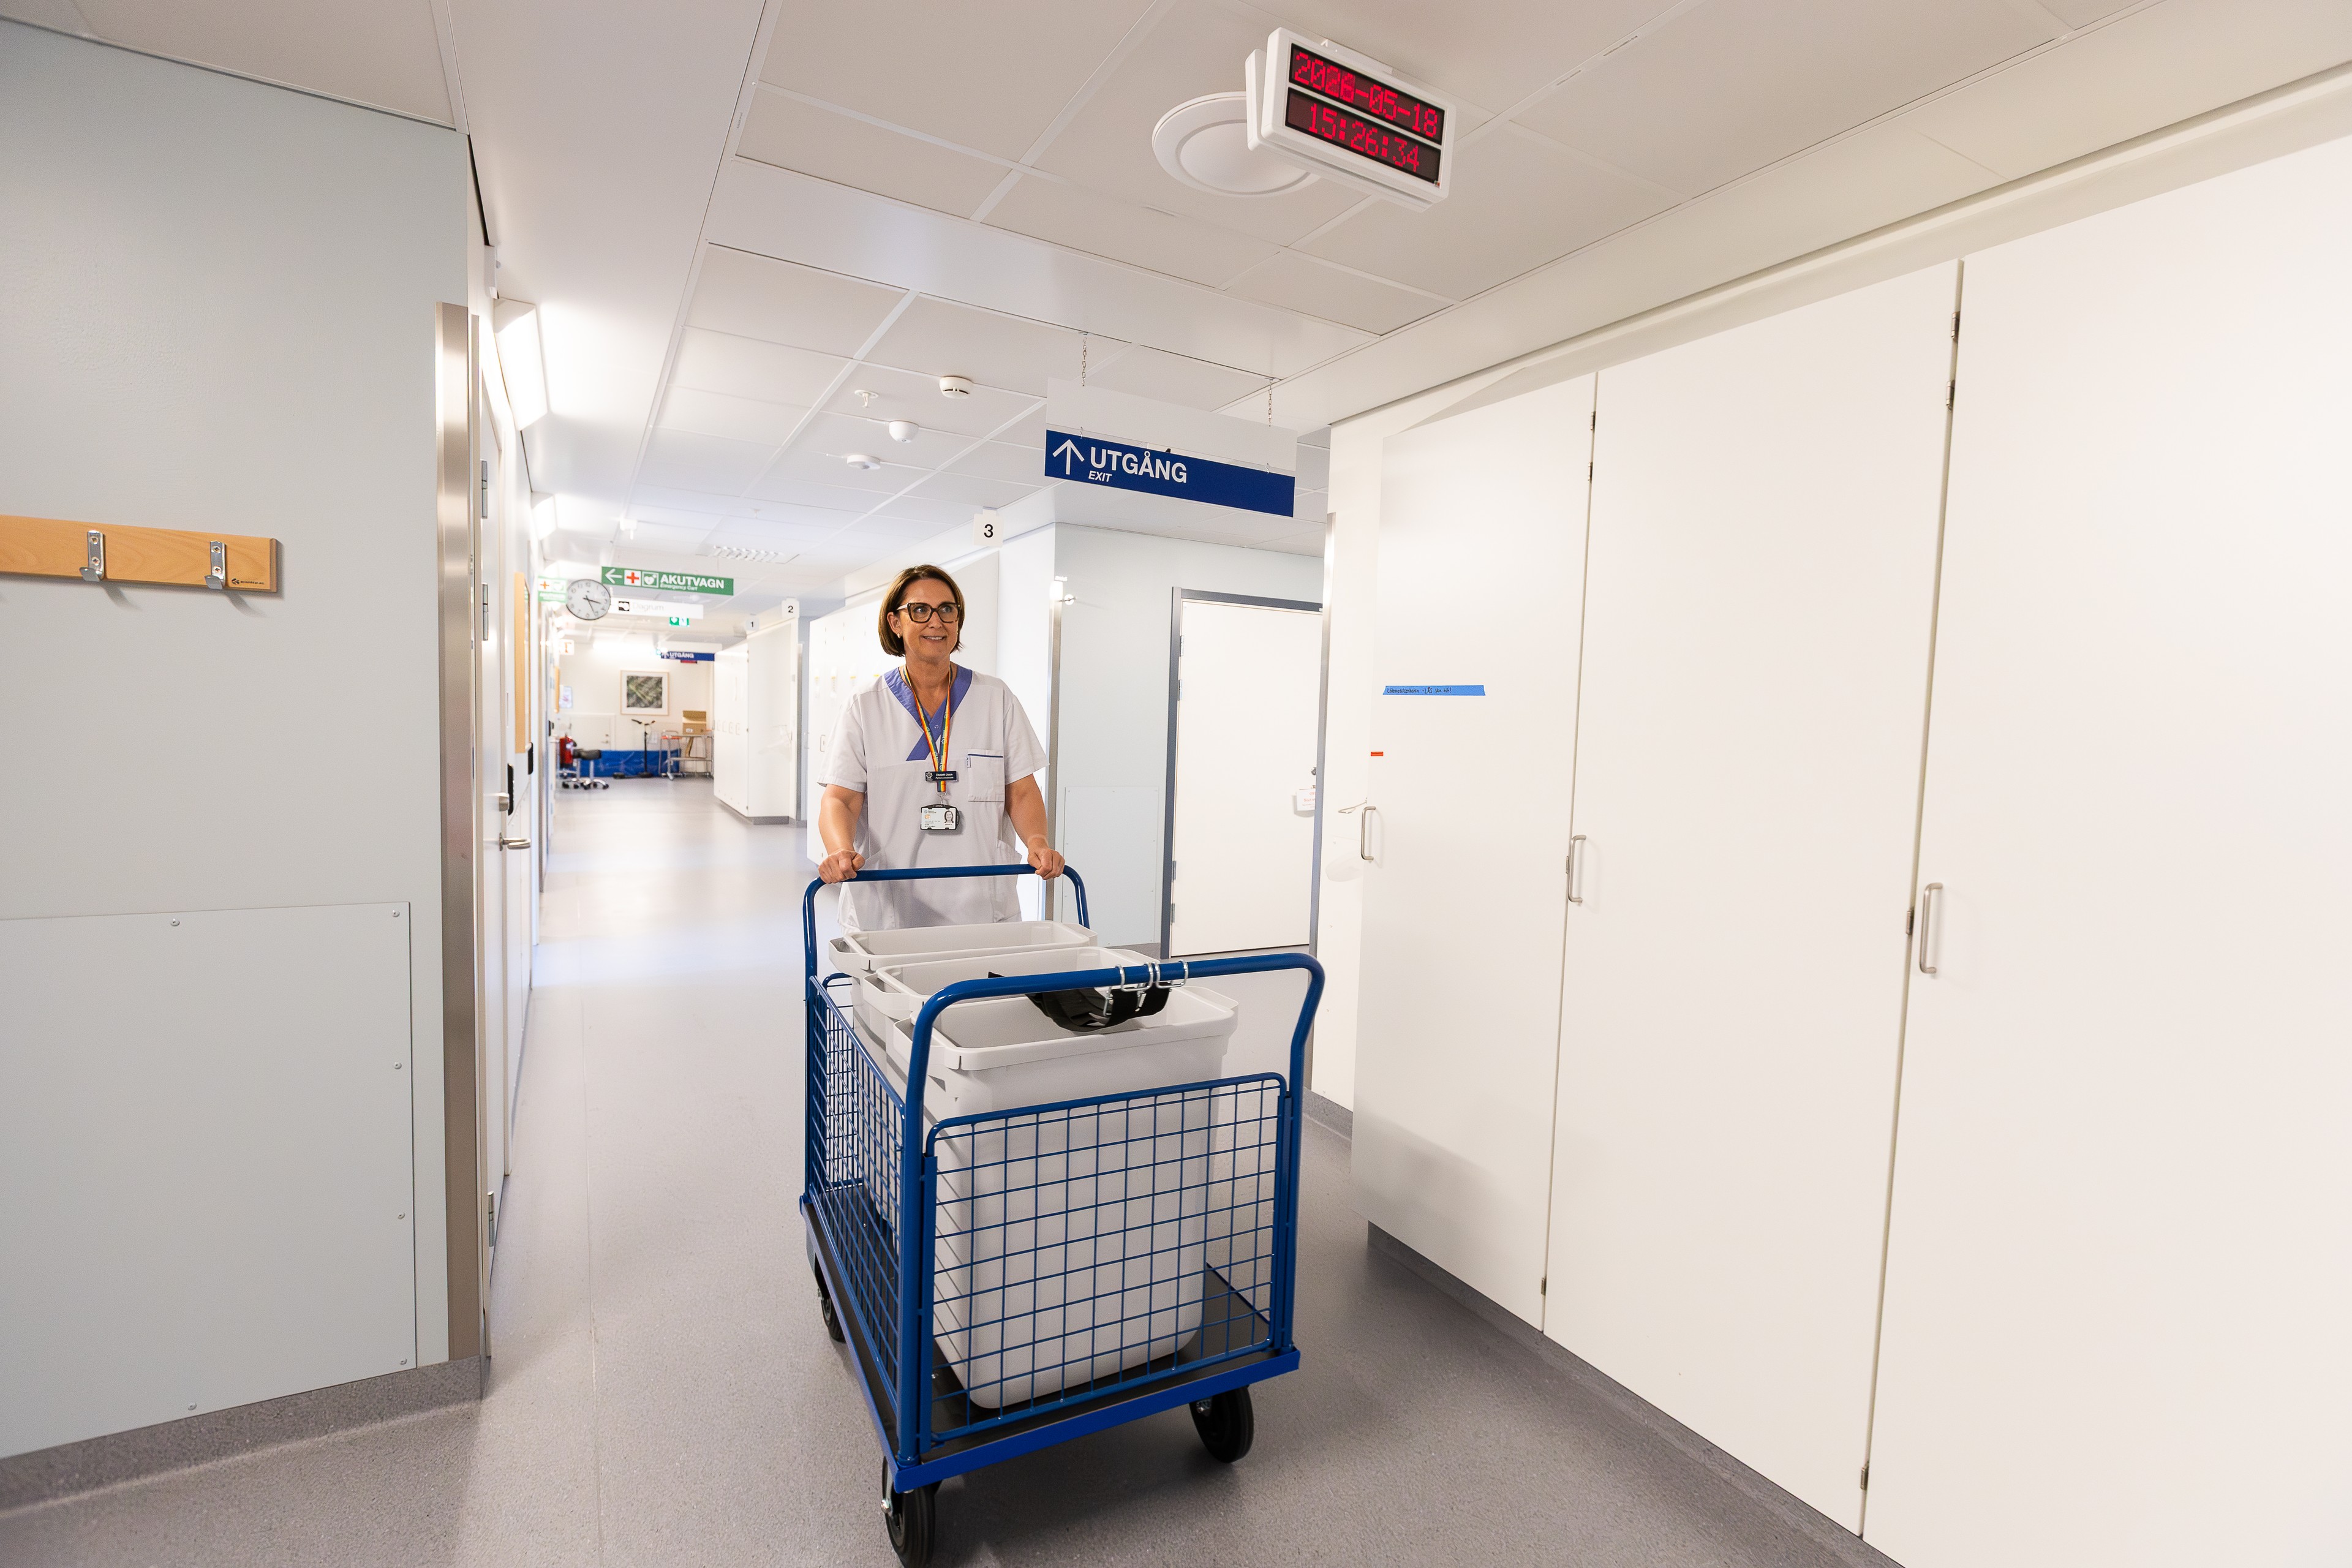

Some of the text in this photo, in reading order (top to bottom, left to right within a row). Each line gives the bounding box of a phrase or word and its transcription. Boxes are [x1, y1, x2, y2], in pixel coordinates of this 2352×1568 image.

[1294, 52, 1438, 137] 2026-05-18
[1308, 103, 1419, 172] 15:26:34
[1088, 470, 1112, 482] EXIT
[1090, 447, 1187, 483] UTGÅNG
[983, 524, 993, 538] 3
[660, 574, 725, 589] AKUTVAGN
